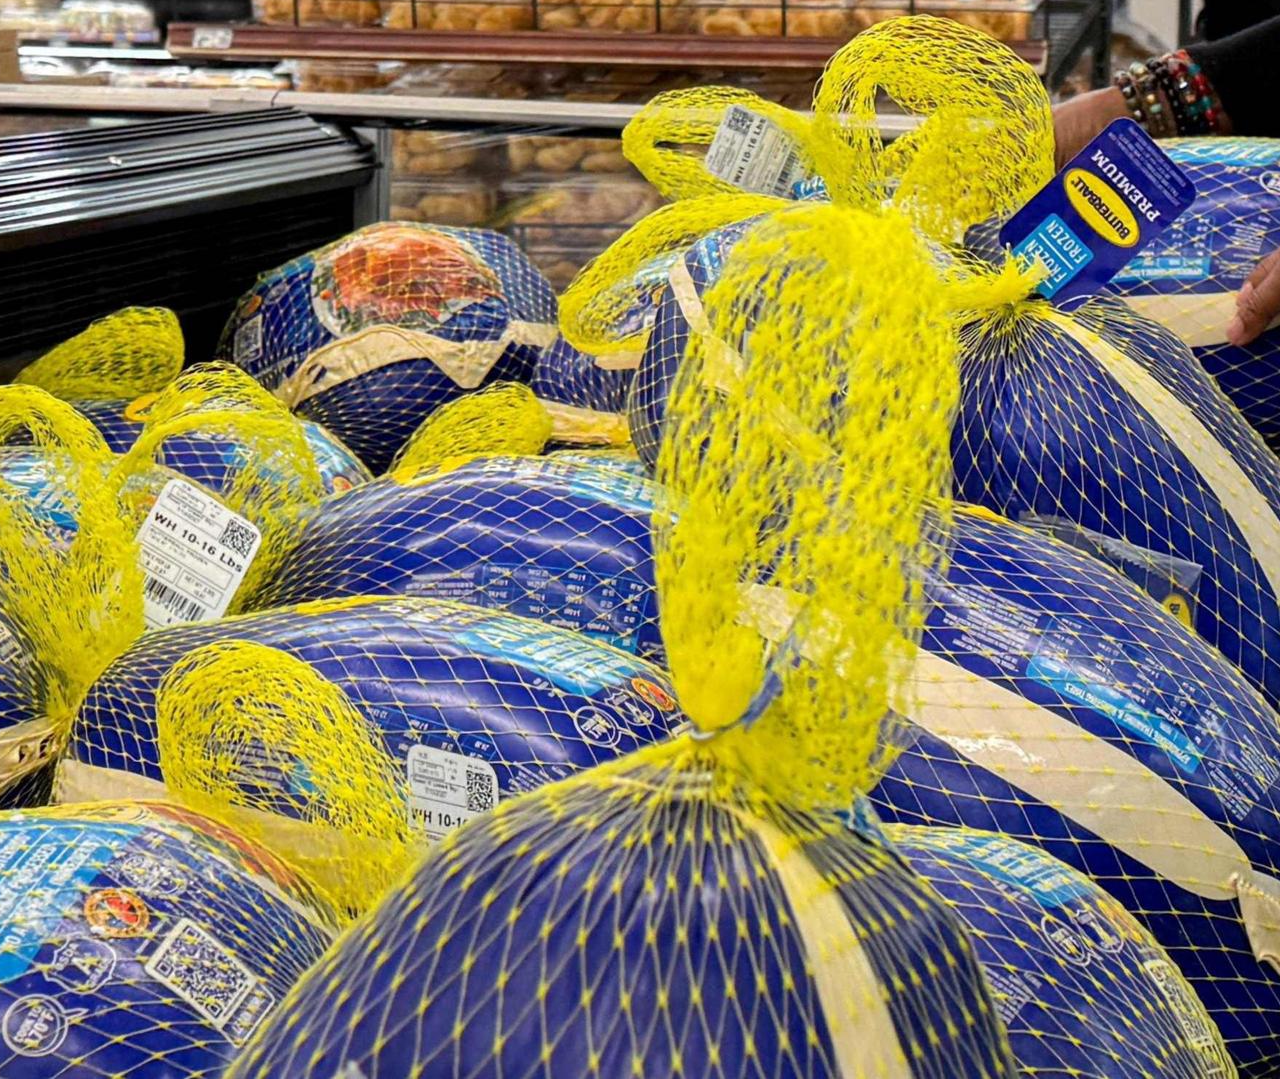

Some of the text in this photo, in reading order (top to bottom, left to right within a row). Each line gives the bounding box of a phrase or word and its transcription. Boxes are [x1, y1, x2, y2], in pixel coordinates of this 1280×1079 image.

[1071, 176, 1133, 240] BUTTERBALL
[1091, 149, 1161, 222] PREMIUM
[1046, 220, 1089, 264] FROZEN
[154, 511, 244, 573] WH 10-16 Lbs
[438, 813, 468, 827] 10-1
